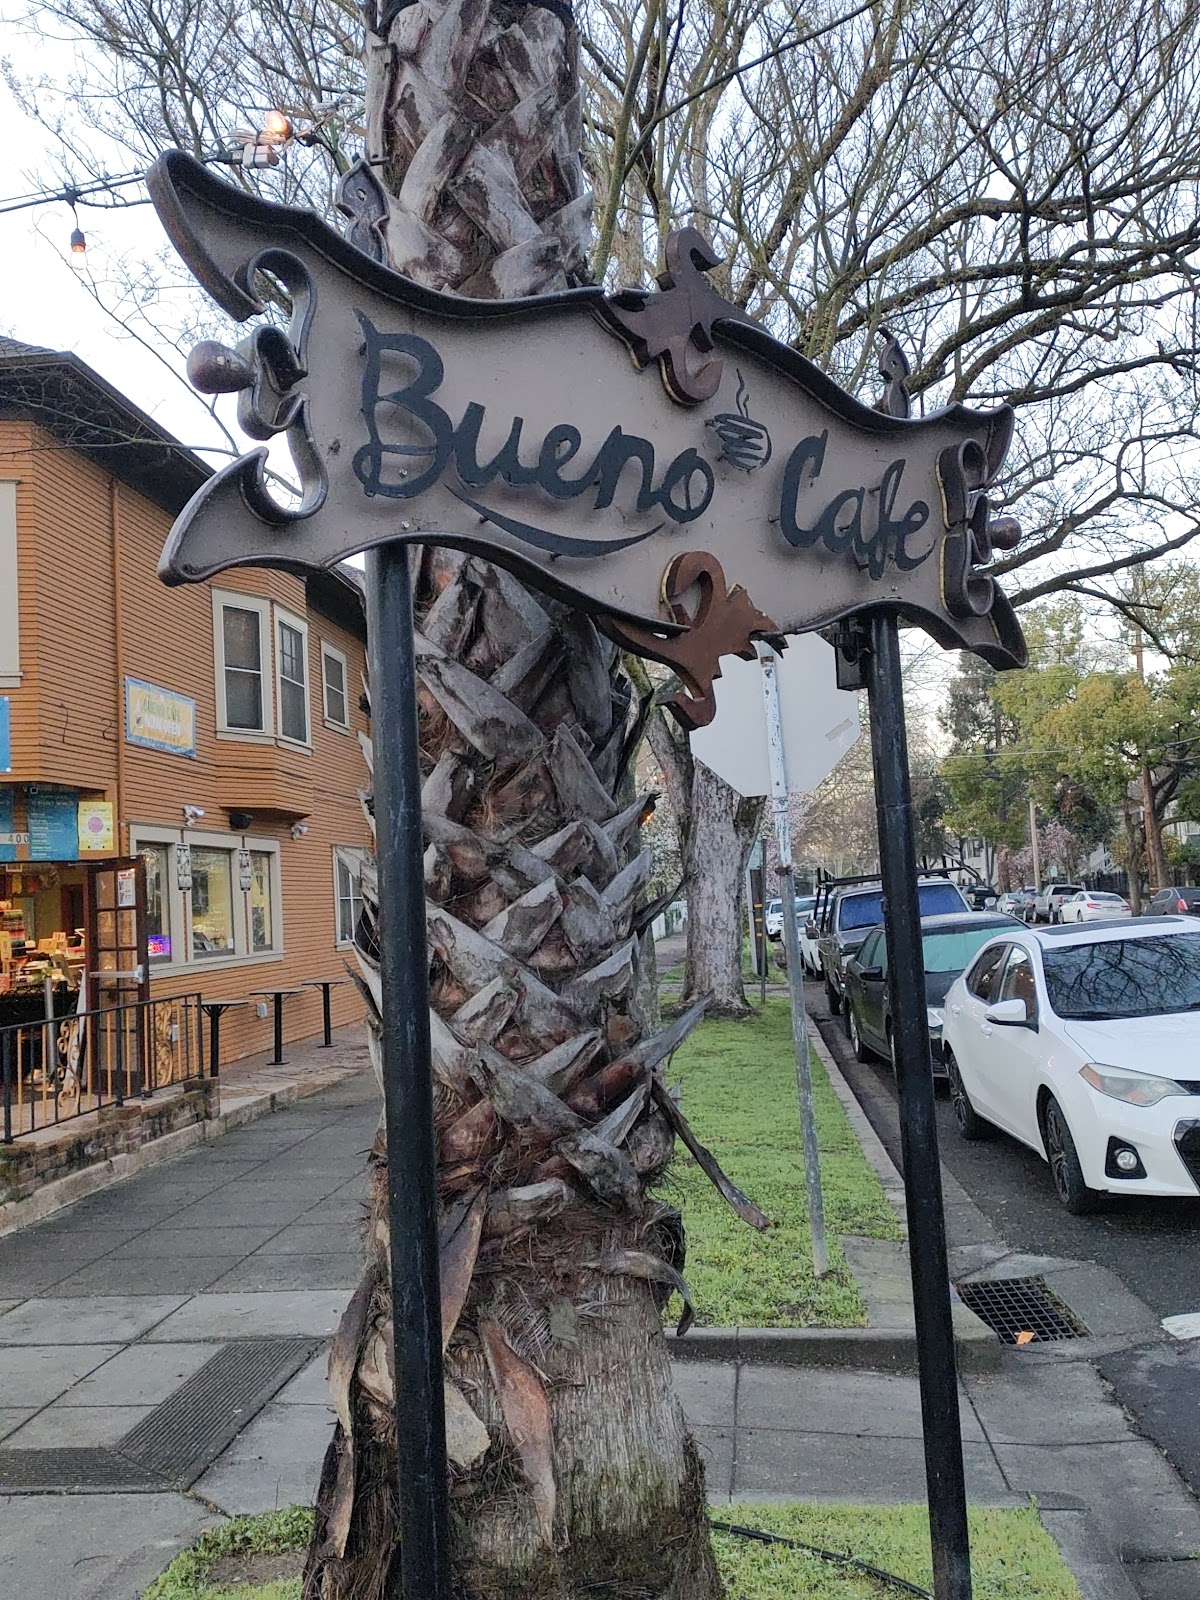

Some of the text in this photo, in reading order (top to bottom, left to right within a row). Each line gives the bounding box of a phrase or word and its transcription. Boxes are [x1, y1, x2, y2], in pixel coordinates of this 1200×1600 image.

[353, 308, 936, 581] Bueno Cafe
[8, 834, 29, 844] 400
